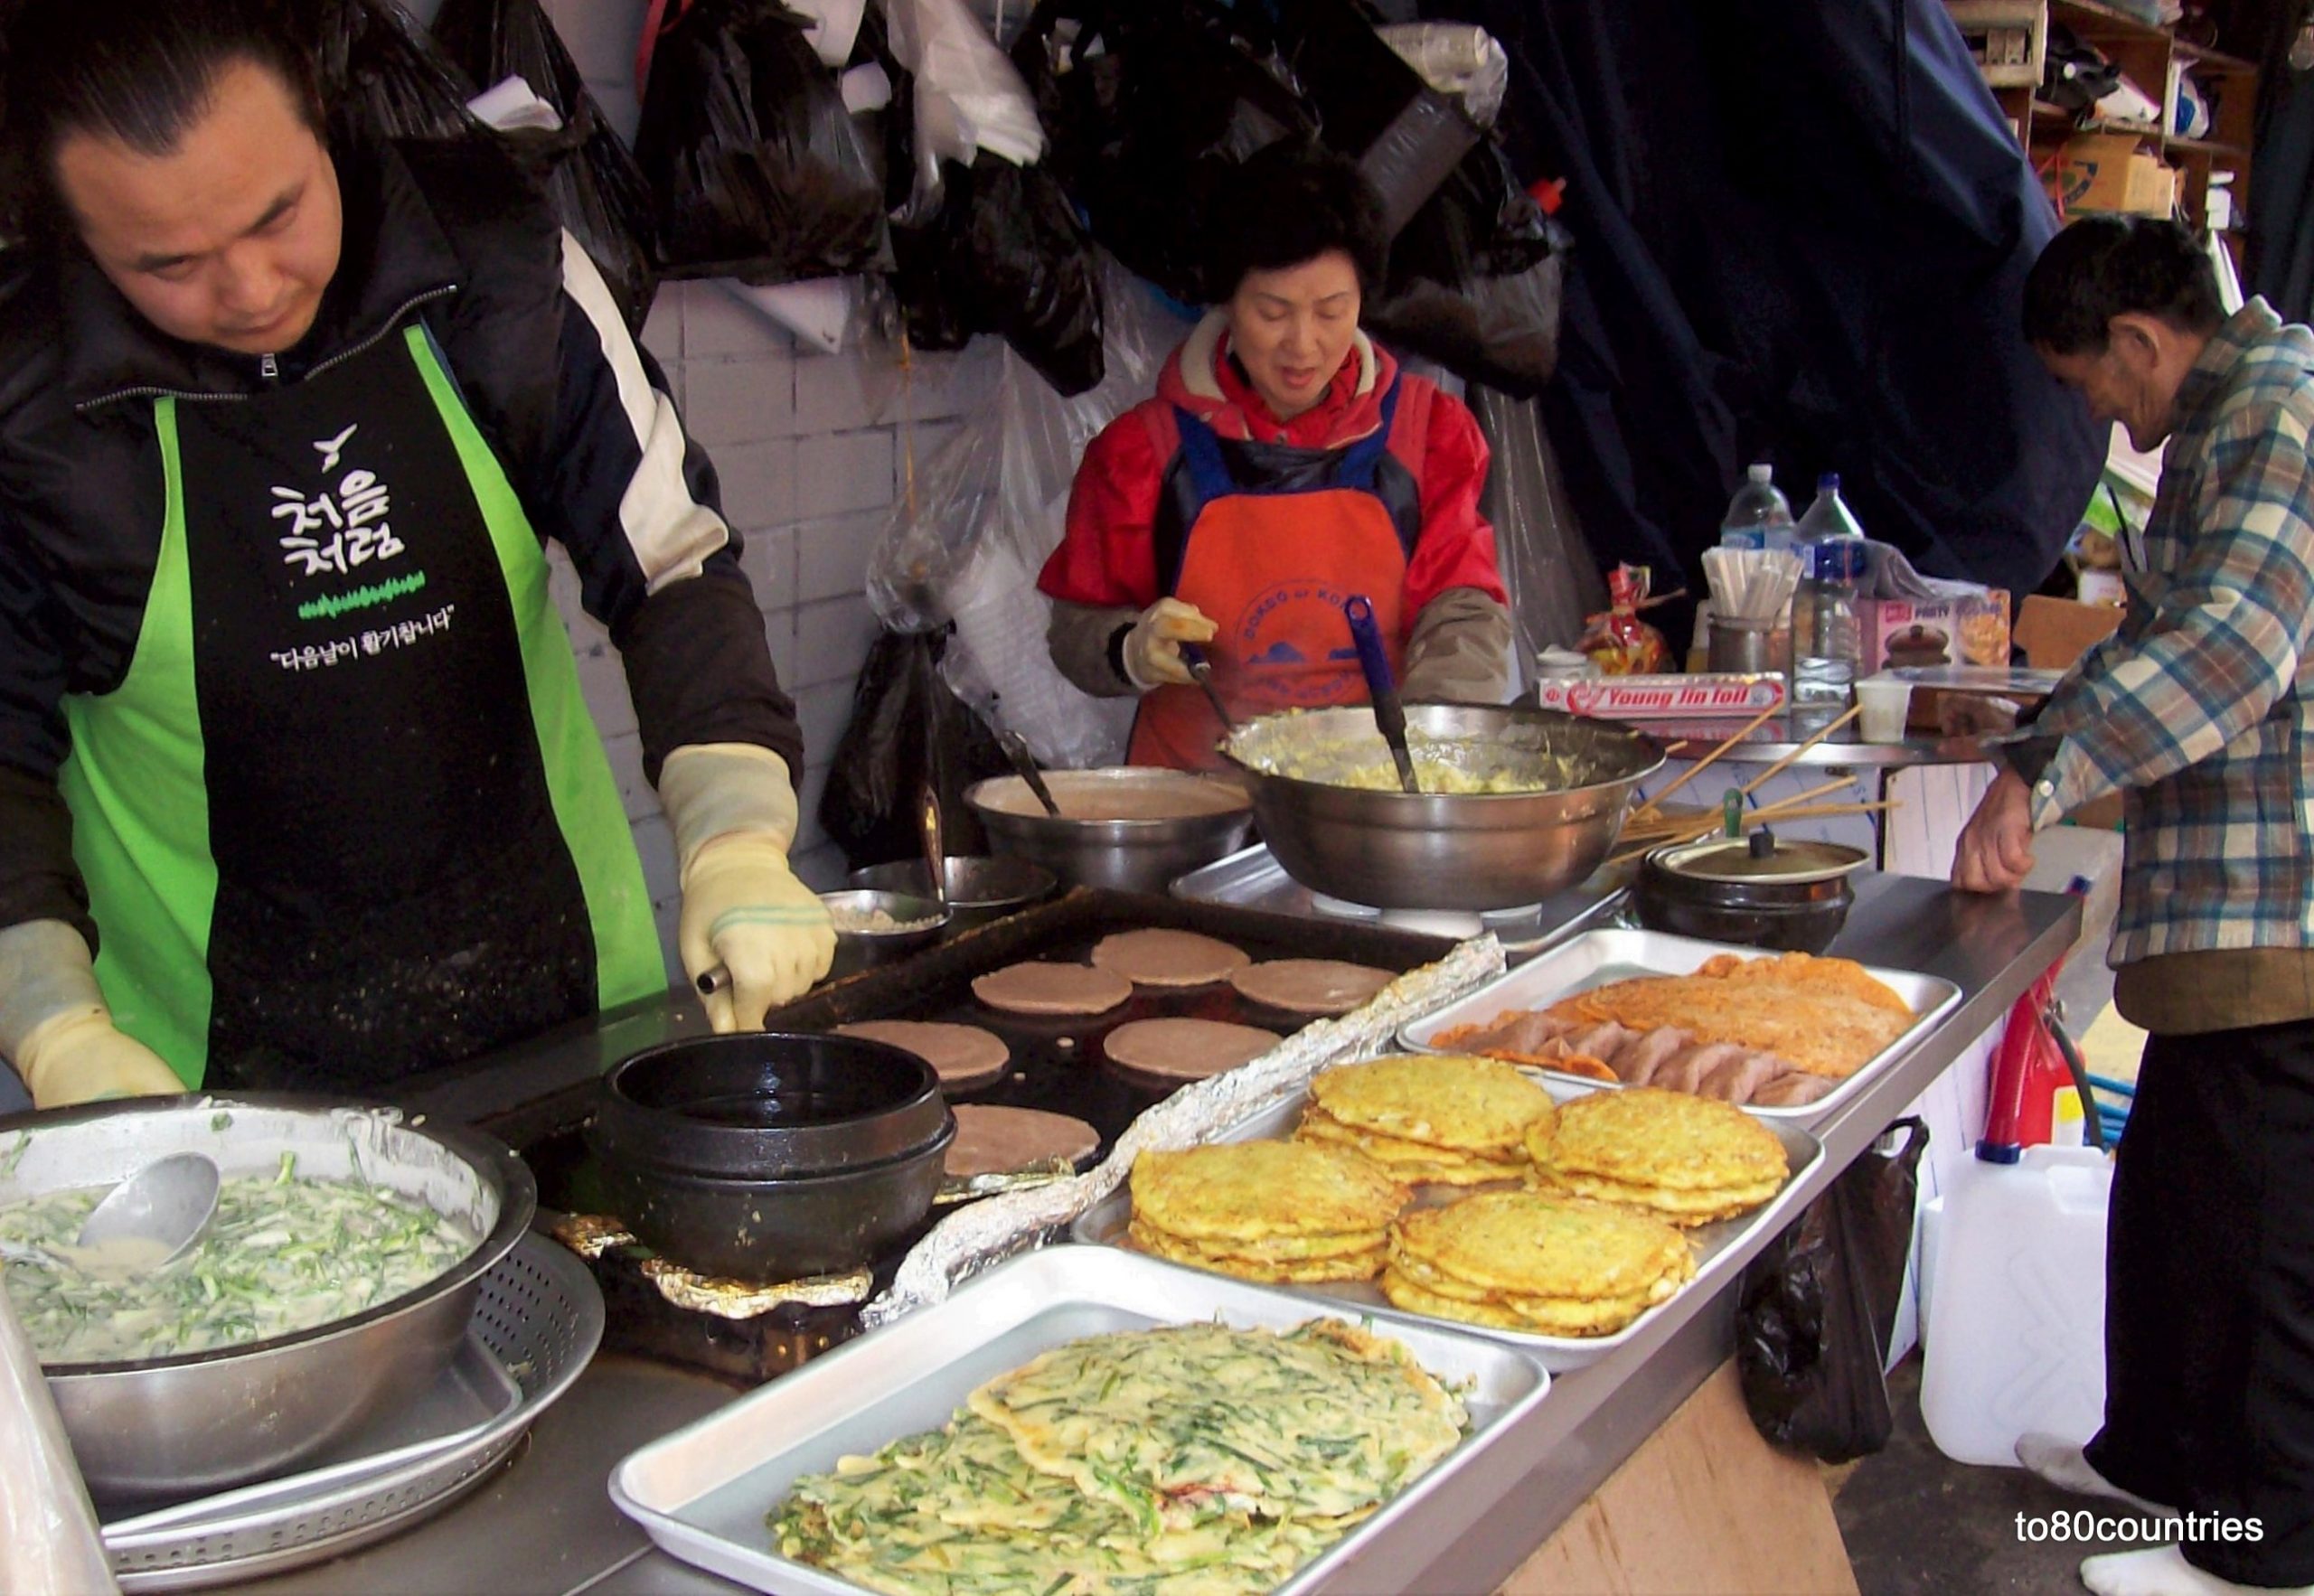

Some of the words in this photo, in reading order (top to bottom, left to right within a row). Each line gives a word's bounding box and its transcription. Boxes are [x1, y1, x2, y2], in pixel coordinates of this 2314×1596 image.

[270, 468, 391, 536] 처음
[278, 521, 406, 577] 처럼
[1608, 688, 1675, 709] Young
